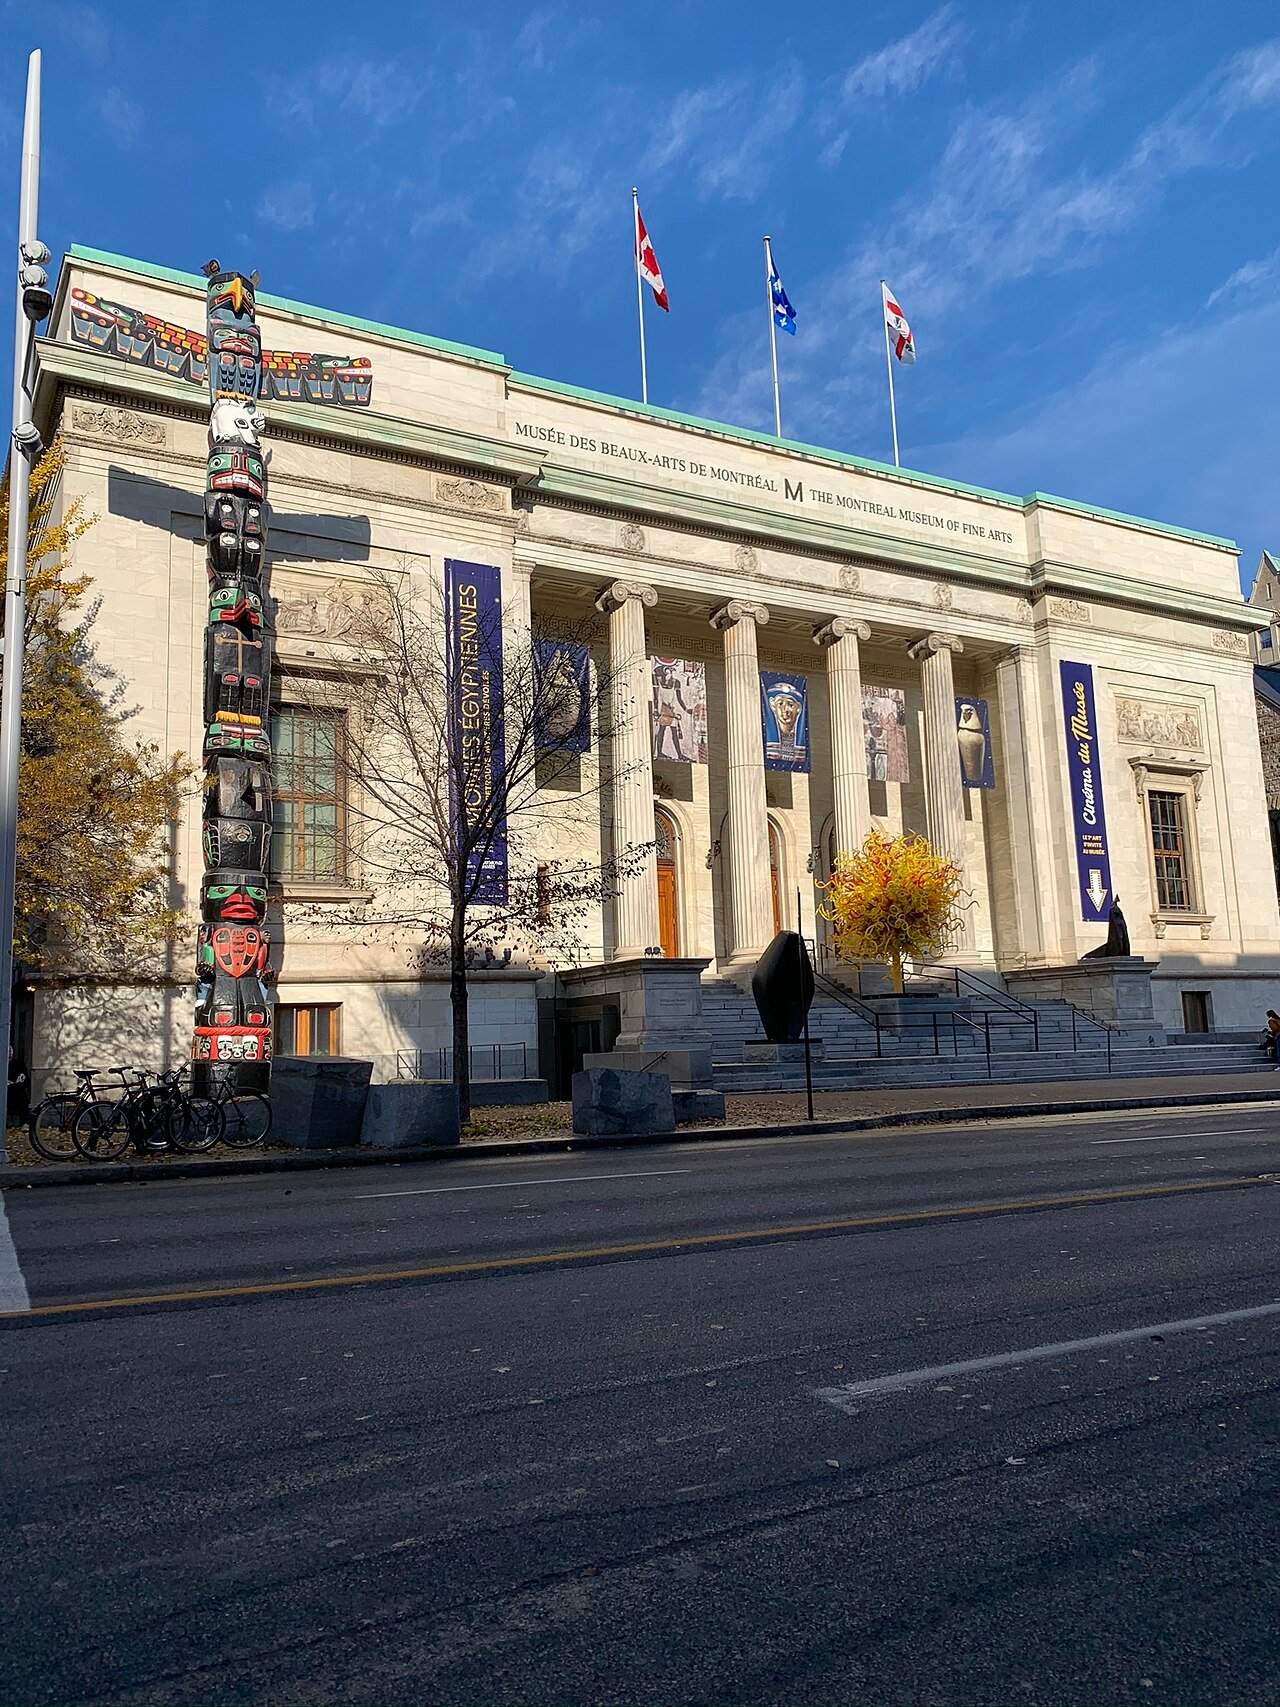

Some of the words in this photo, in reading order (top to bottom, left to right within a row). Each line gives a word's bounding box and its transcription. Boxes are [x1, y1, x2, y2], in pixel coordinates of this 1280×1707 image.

[515, 422, 565, 445] MUSÉE
[570, 435, 597, 452] DES
[601, 442, 686, 472] BEAUX-ARTS
[690, 462, 707, 477] DE
[710, 466, 778, 492] MONTRÉAL
[784, 478, 803, 502] M
[810, 489, 833, 504] THE
[836, 495, 896, 518] MONTREAL
[899, 509, 944, 529] MUSEUM
[946, 519, 960, 531] OF
[962, 523, 985, 538] FINE
[987, 529, 1013, 544] ARTS
[457, 583, 480, 729] ÉGYPTIENNES
[1070, 681, 1093, 741] Musée
[1077, 742, 1091, 764] du
[1081, 767, 1096, 825] Cinéma
